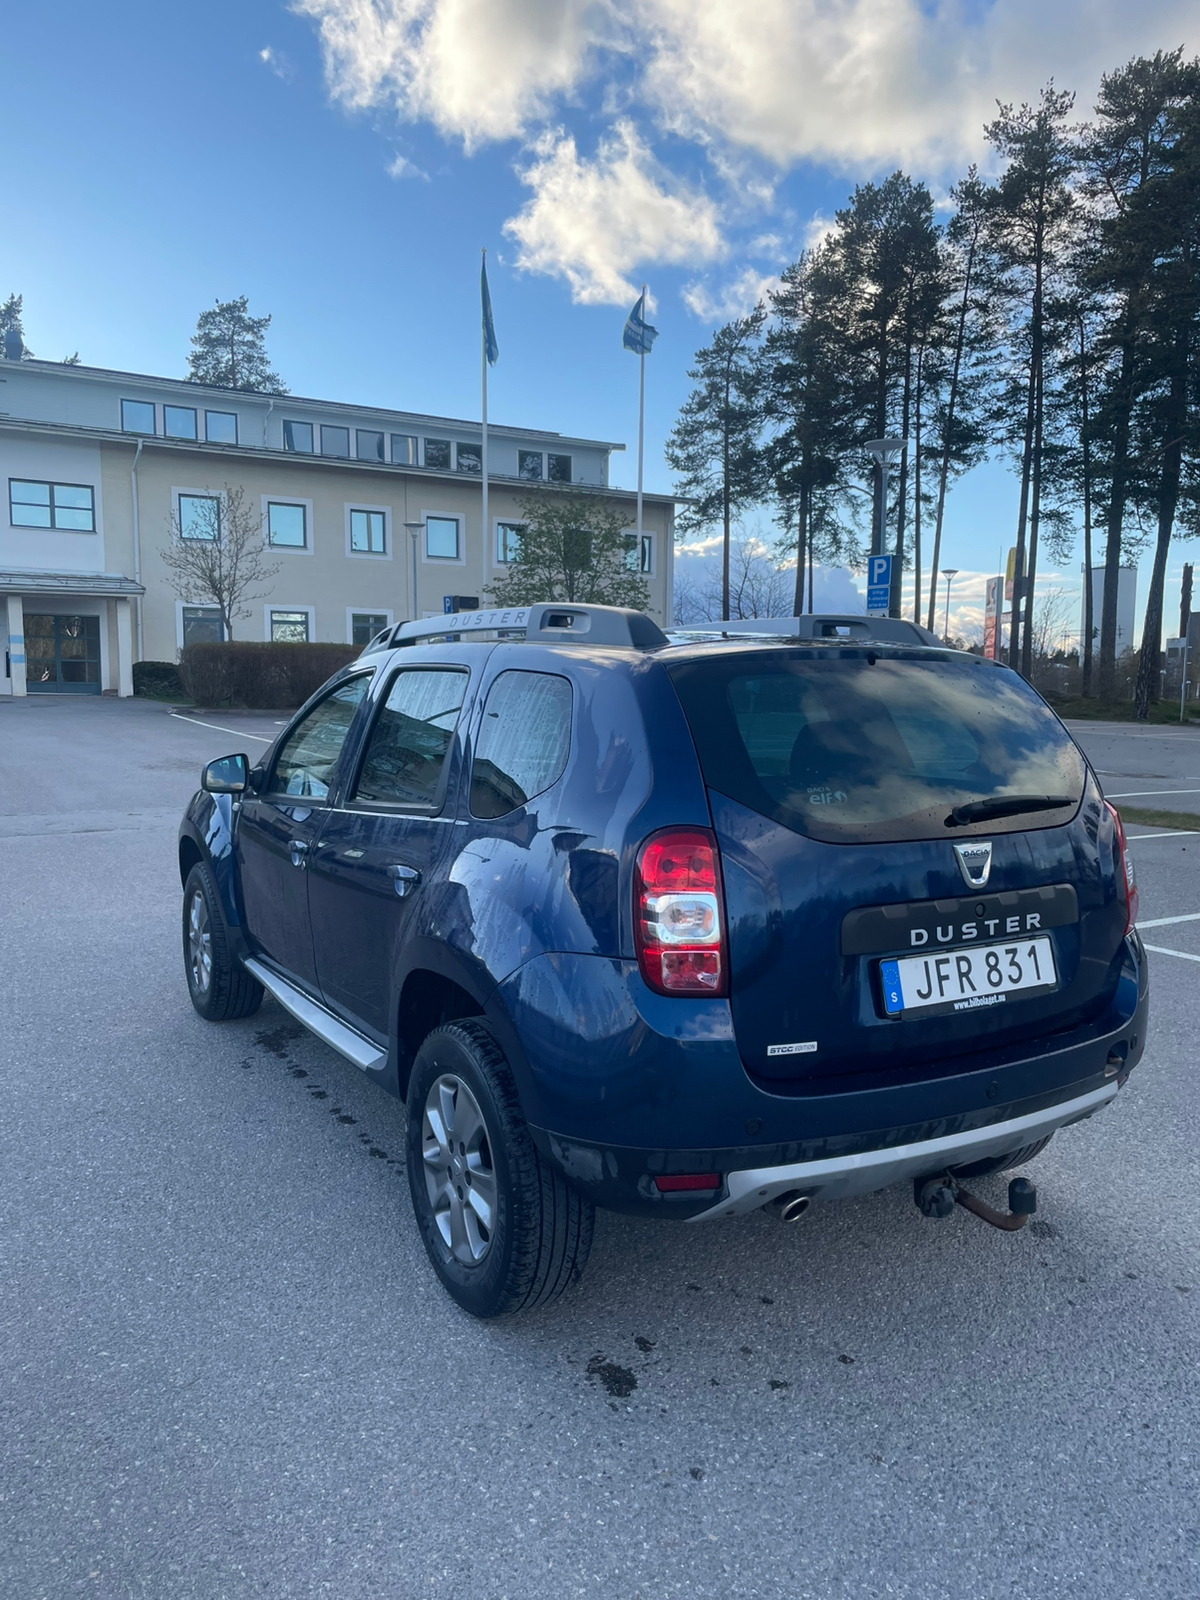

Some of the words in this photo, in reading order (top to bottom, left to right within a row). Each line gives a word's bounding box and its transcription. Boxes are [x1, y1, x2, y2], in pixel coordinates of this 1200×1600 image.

[873, 559, 887, 584] P
[445, 597, 451, 613] P
[449, 611, 526, 628] DUSTER
[810, 792, 833, 805] elf
[963, 849, 989, 857] DACIA
[910, 912, 1041, 946] DUSTER
[916, 955, 977, 1000] JFR
[984, 944, 1041, 988] 831
[890, 991, 898, 1003] S
[794, 1043, 816, 1052] EDITION
